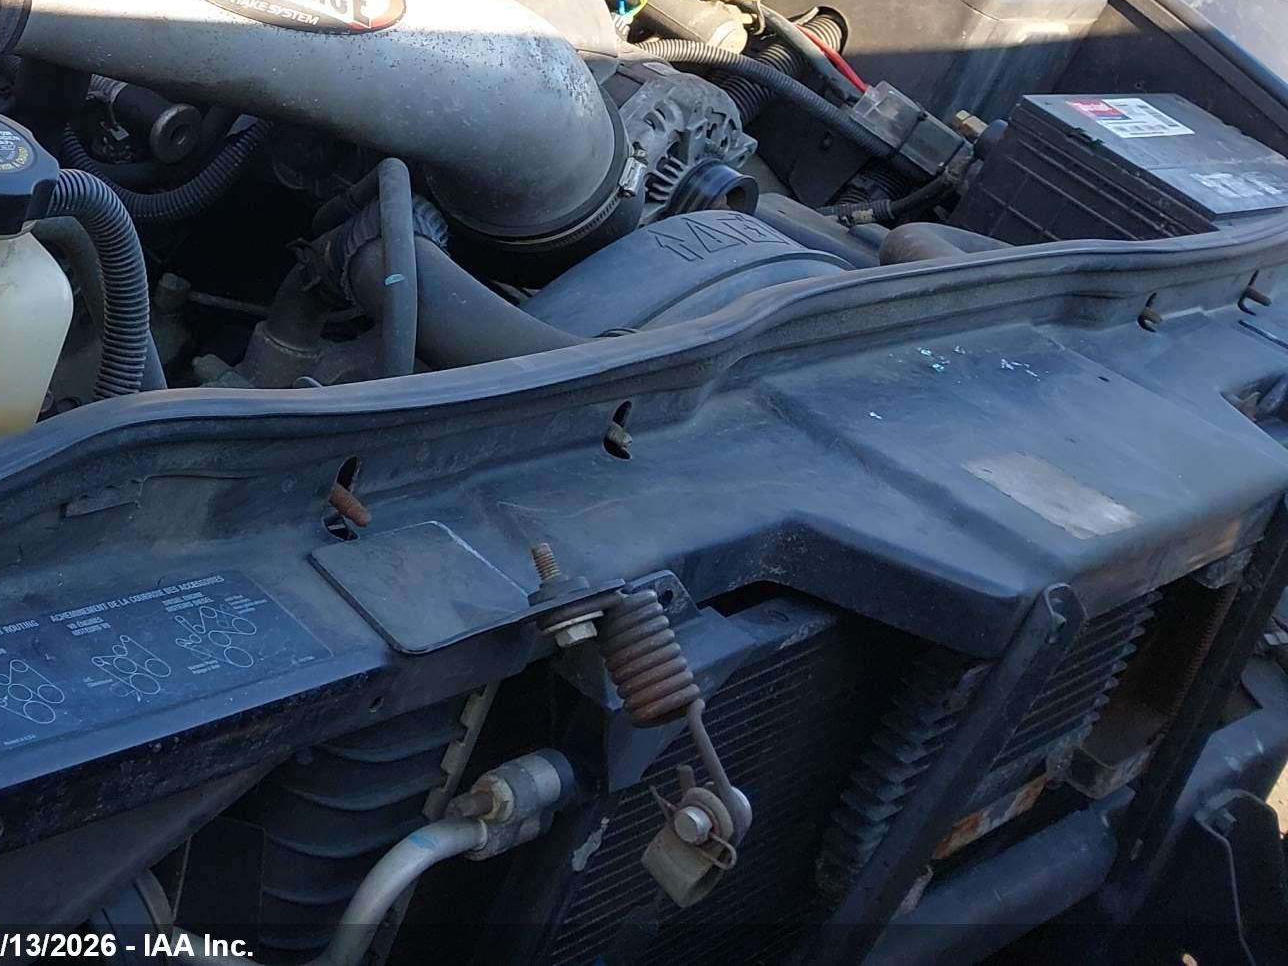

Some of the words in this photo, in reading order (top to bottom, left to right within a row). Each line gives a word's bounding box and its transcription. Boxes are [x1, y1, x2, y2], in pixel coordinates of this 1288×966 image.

[267, 1, 320, 26] SYSTEM
[107, 598, 120, 609] DE
[118, 595, 130, 607] LA
[2, 619, 40, 634] ROUTING
